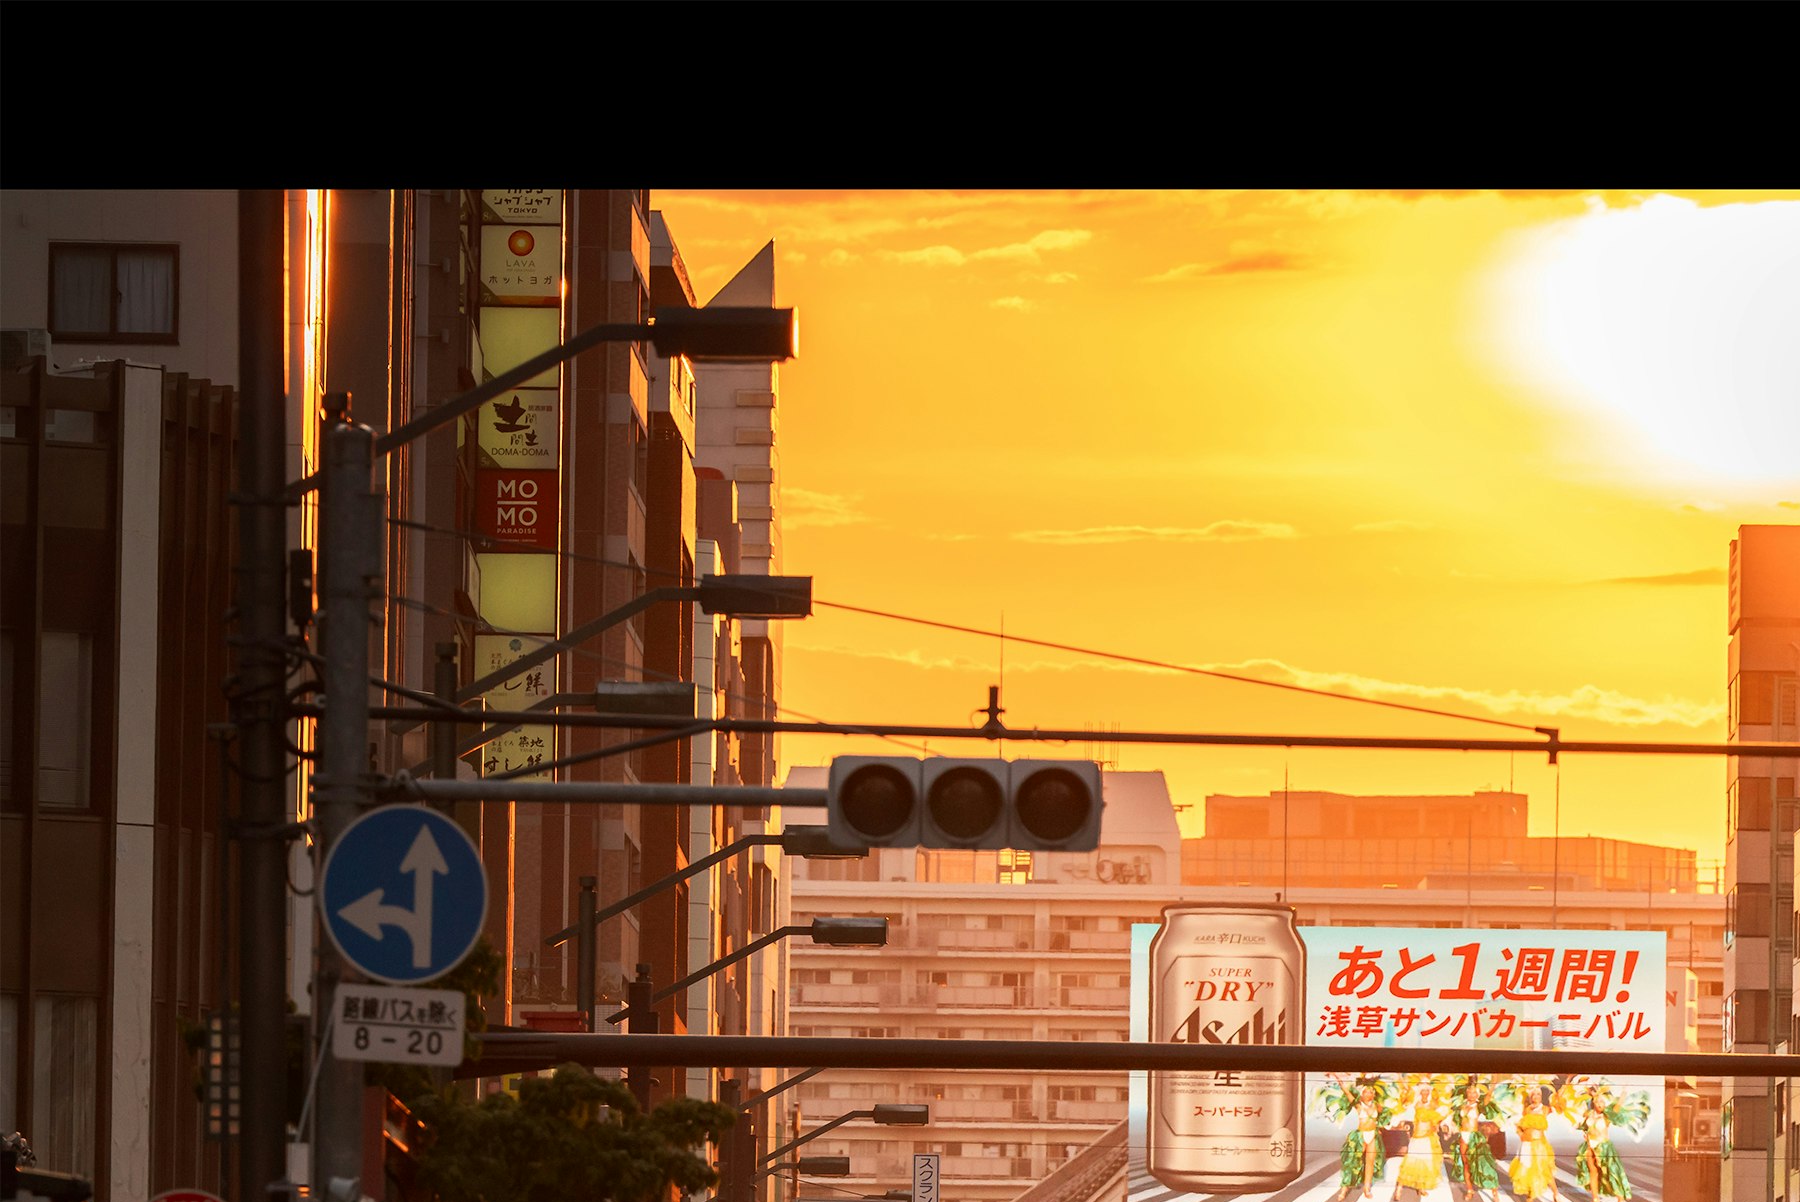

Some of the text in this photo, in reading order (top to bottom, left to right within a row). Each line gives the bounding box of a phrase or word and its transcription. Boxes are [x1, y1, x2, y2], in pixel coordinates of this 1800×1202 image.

[506, 260, 536, 268] LAVA
[488, 275, 552, 285] ホットヨガ
[497, 480, 538, 499] MO
[497, 507, 538, 526] MO
[1217, 933, 1243, 944] 辛口
[1208, 967, 1253, 978] SUPER
[1328, 942, 1640, 1003] あと1週間!
[1170, 1005, 1287, 1044] Asahi
[1316, 1005, 1652, 1040] 浅草サンバカーニバル
[1193, 1106, 1263, 1117] スーパードライ
[1270, 1140, 1294, 1158] お酒
